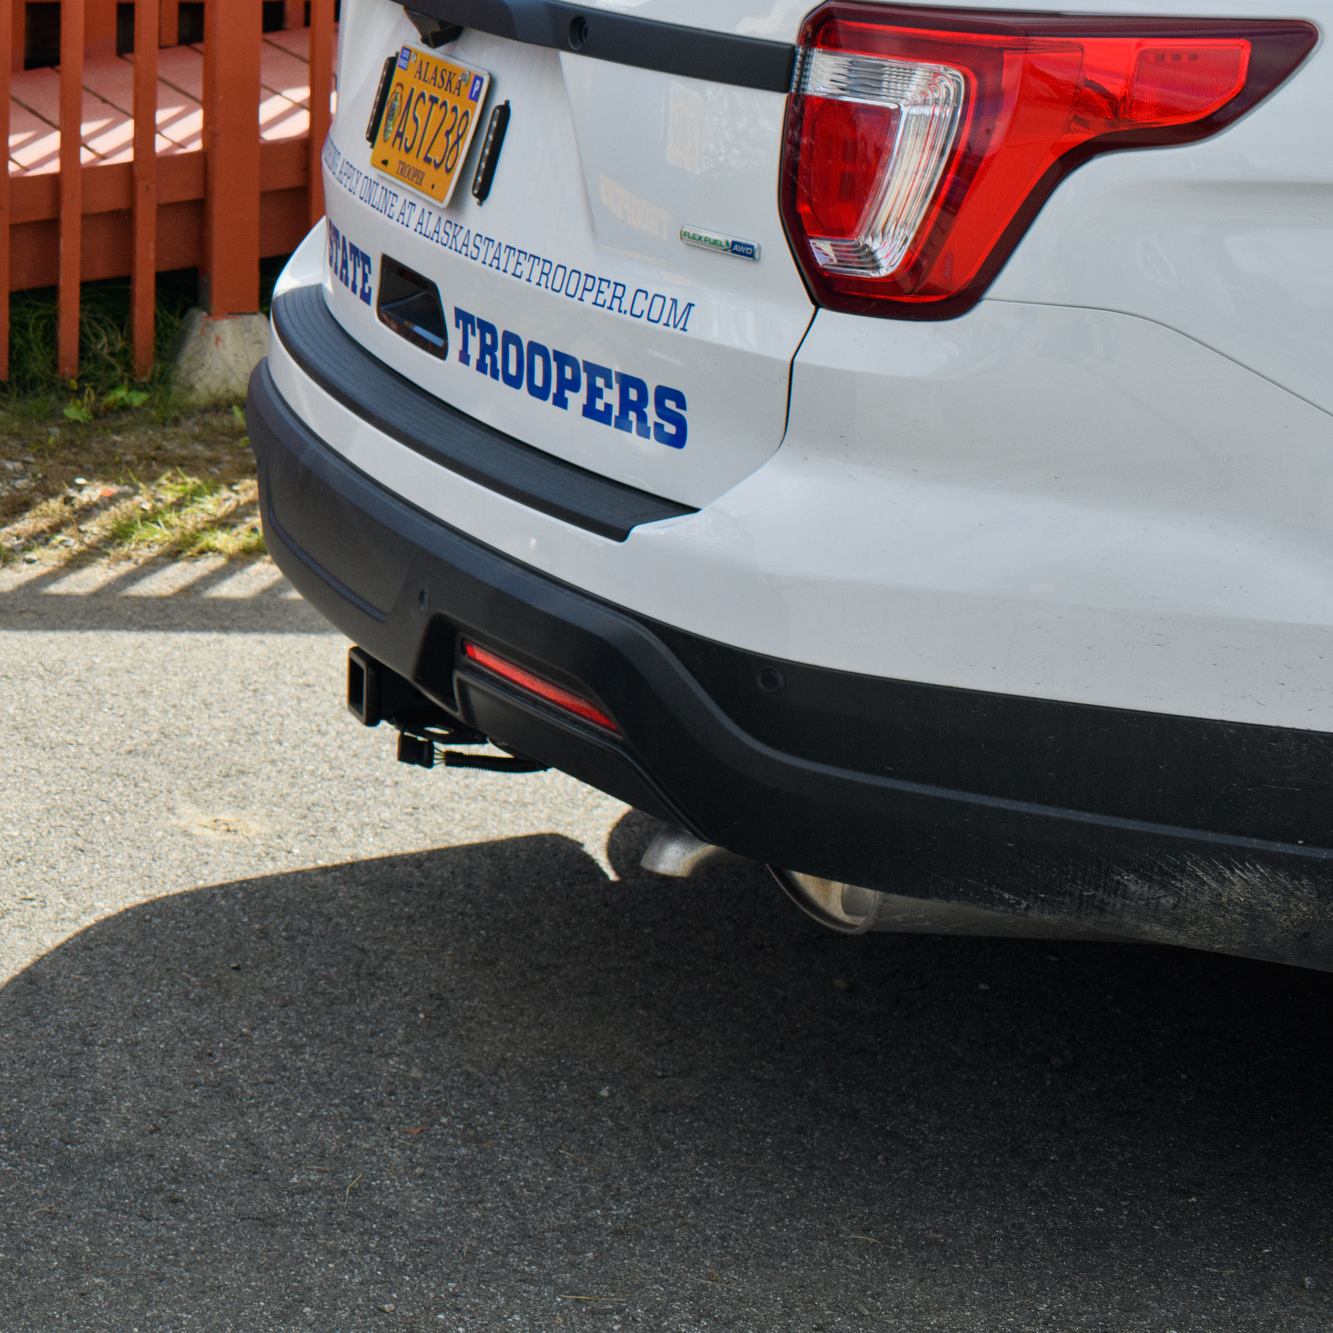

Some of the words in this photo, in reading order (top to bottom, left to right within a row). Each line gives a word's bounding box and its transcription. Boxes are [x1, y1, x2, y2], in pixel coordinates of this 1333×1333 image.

[414, 59, 461, 97] ALASKA
[391, 85, 471, 175] AST238
[395, 160, 426, 187] TROOPER
[336, 157, 363, 196] APPLY
[359, 174, 399, 220] ONLINE
[396, 197, 417, 228] AT
[414, 207, 696, 333] ALASKASTATETROOPER.COM
[682, 230, 704, 243] FLEX
[704, 235, 726, 248] FUEL
[732, 244, 753, 255] AWD
[327, 217, 373, 307] STATE
[453, 306, 688, 450] TROOPERS
